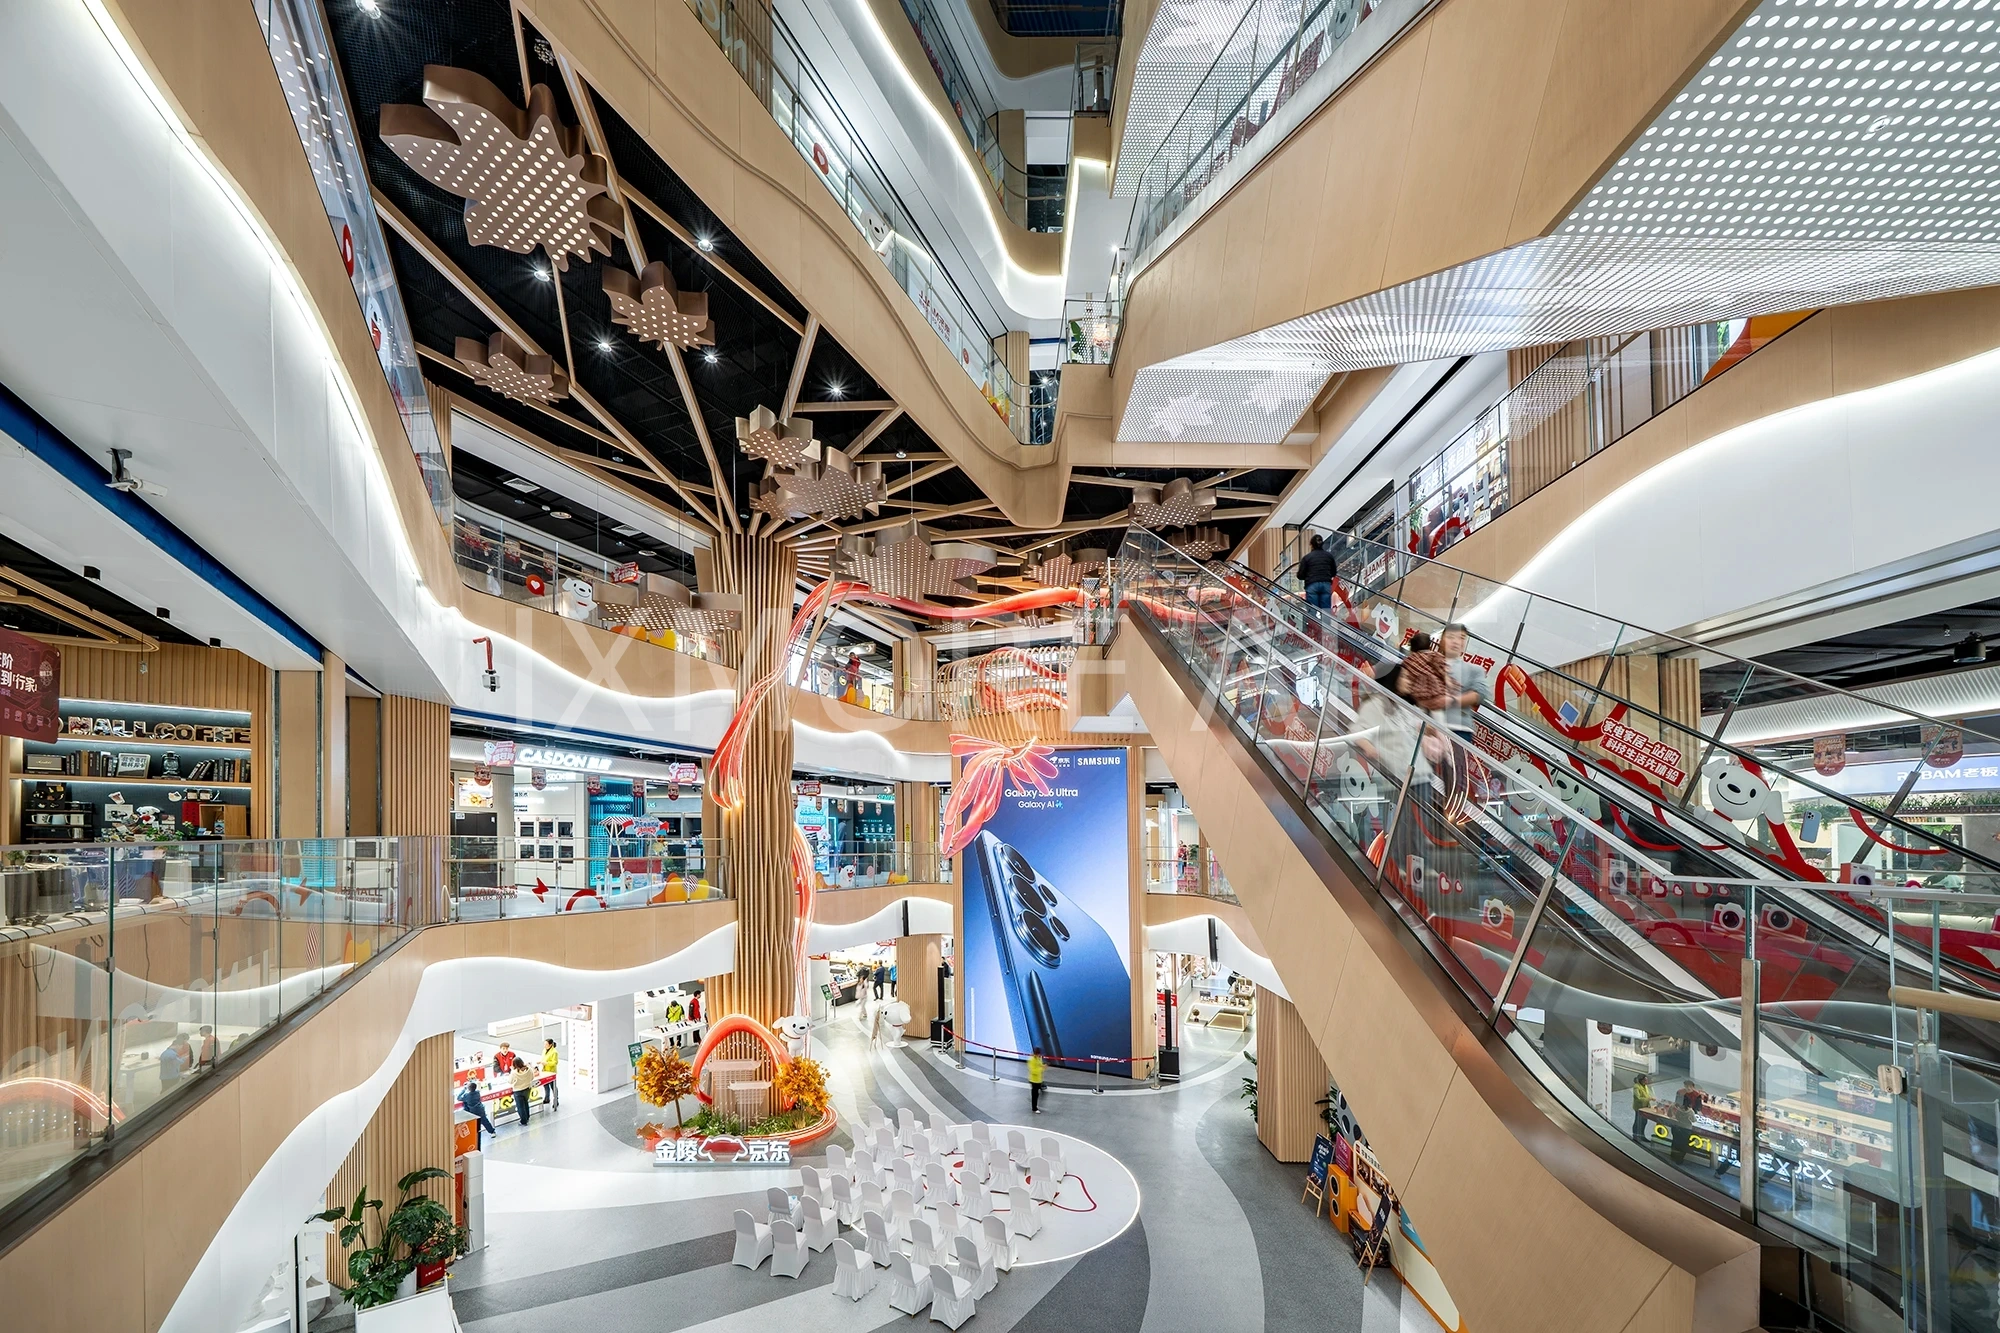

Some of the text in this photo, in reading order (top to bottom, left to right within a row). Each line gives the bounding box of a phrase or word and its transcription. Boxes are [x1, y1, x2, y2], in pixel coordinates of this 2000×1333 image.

[1603, 718, 1678, 765] 家电家居一站购
[518, 748, 587, 767] CASDON
[1077, 756, 1121, 766] SAMSUNG
[1606, 738, 1680, 782] 科技生活先体验
[1897, 766, 1999, 781] RBAM 老板
[1038, 788, 1054, 797] S6
[1055, 788, 1078, 797] Ultra
[1018, 800, 1055, 810] Galaxy AI
[655, 1139, 791, 1162] 金陵 京东
